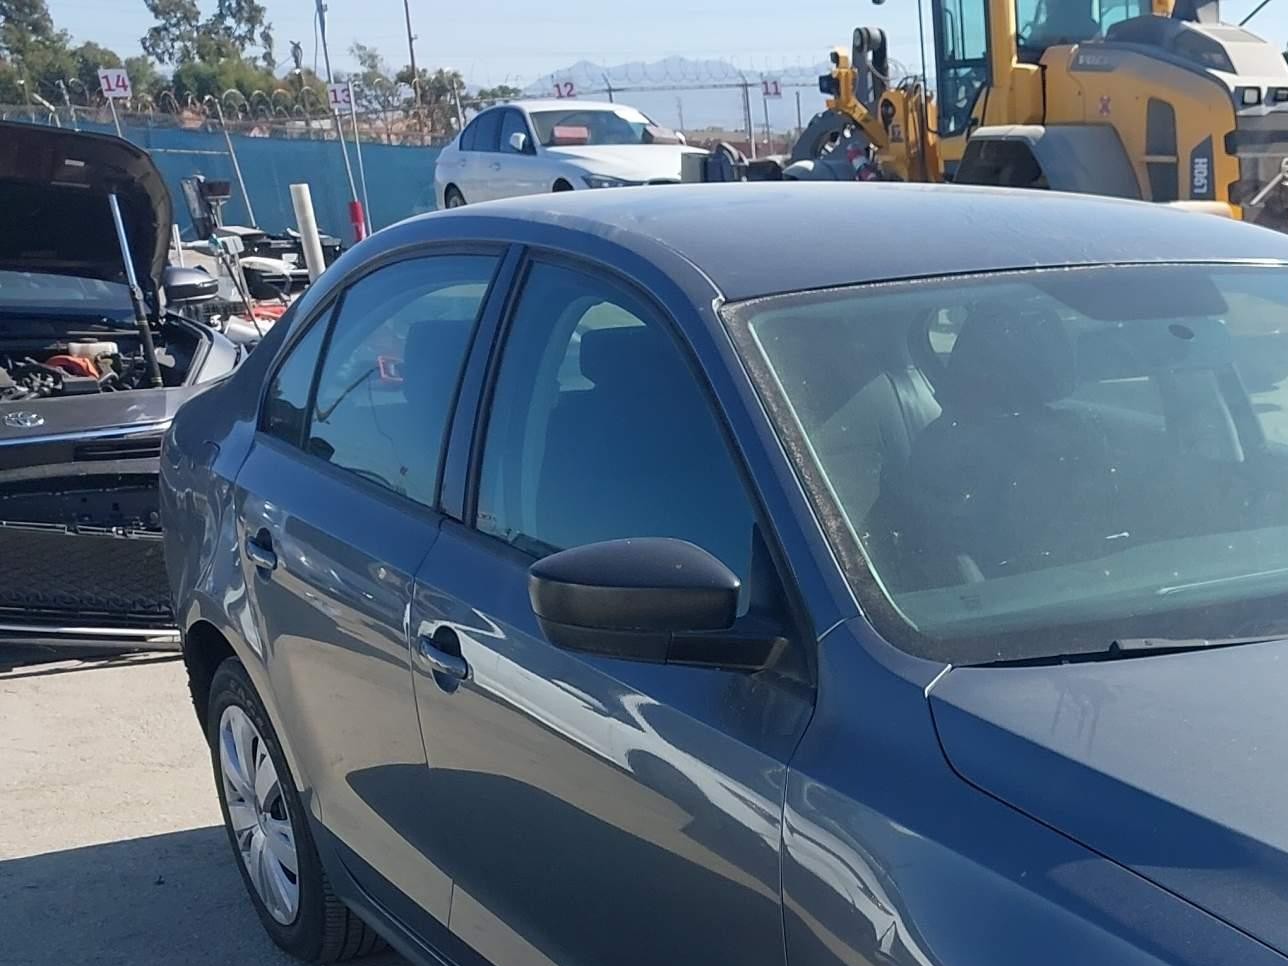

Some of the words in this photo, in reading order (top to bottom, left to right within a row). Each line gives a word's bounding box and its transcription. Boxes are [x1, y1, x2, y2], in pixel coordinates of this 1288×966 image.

[101, 74, 129, 92] 14
[553, 82, 577, 99] 12
[762, 80, 782, 96] 11
[330, 88, 351, 104] 13
[1193, 158, 1209, 194] L90H
